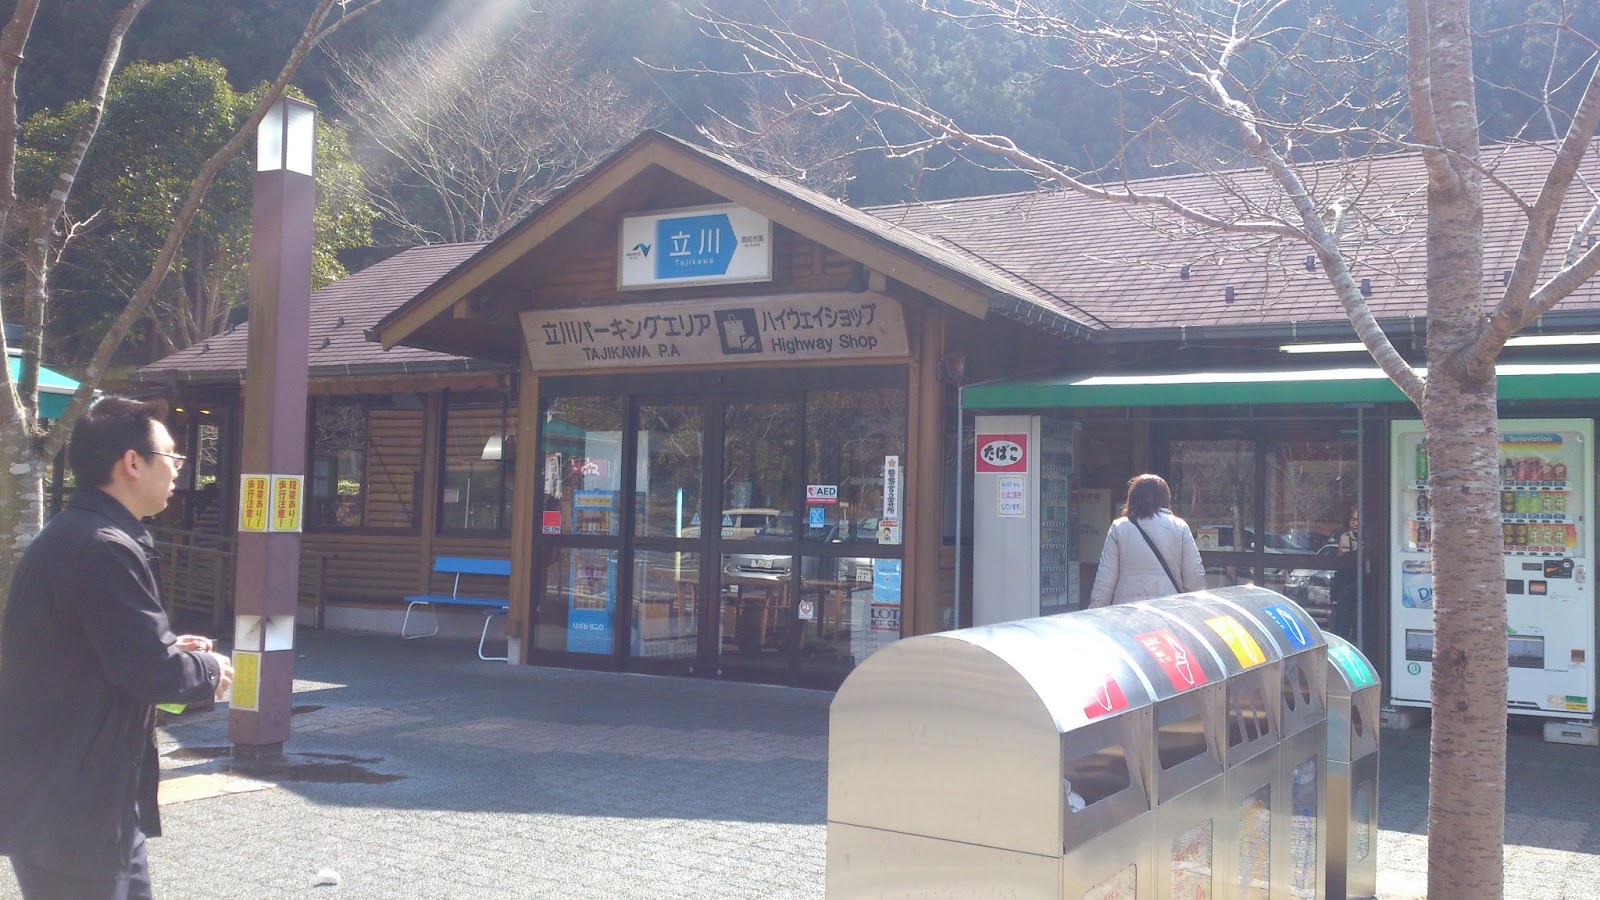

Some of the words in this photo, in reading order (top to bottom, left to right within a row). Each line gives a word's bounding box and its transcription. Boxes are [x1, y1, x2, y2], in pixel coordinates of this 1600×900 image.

[670, 228, 720, 257] 立川
[675, 258, 714, 267] Tajikawa
[762, 303, 877, 333] ハイウェイショップ
[542, 314, 711, 346] 立川パーキングエリア
[582, 345, 651, 361] TAJIKAWA
[659, 343, 681, 358] P.A
[771, 336, 833, 355] Highway
[839, 333, 878, 350] Shop
[984, 444, 1018, 461] たばこ
[816, 487, 836, 496] AED
